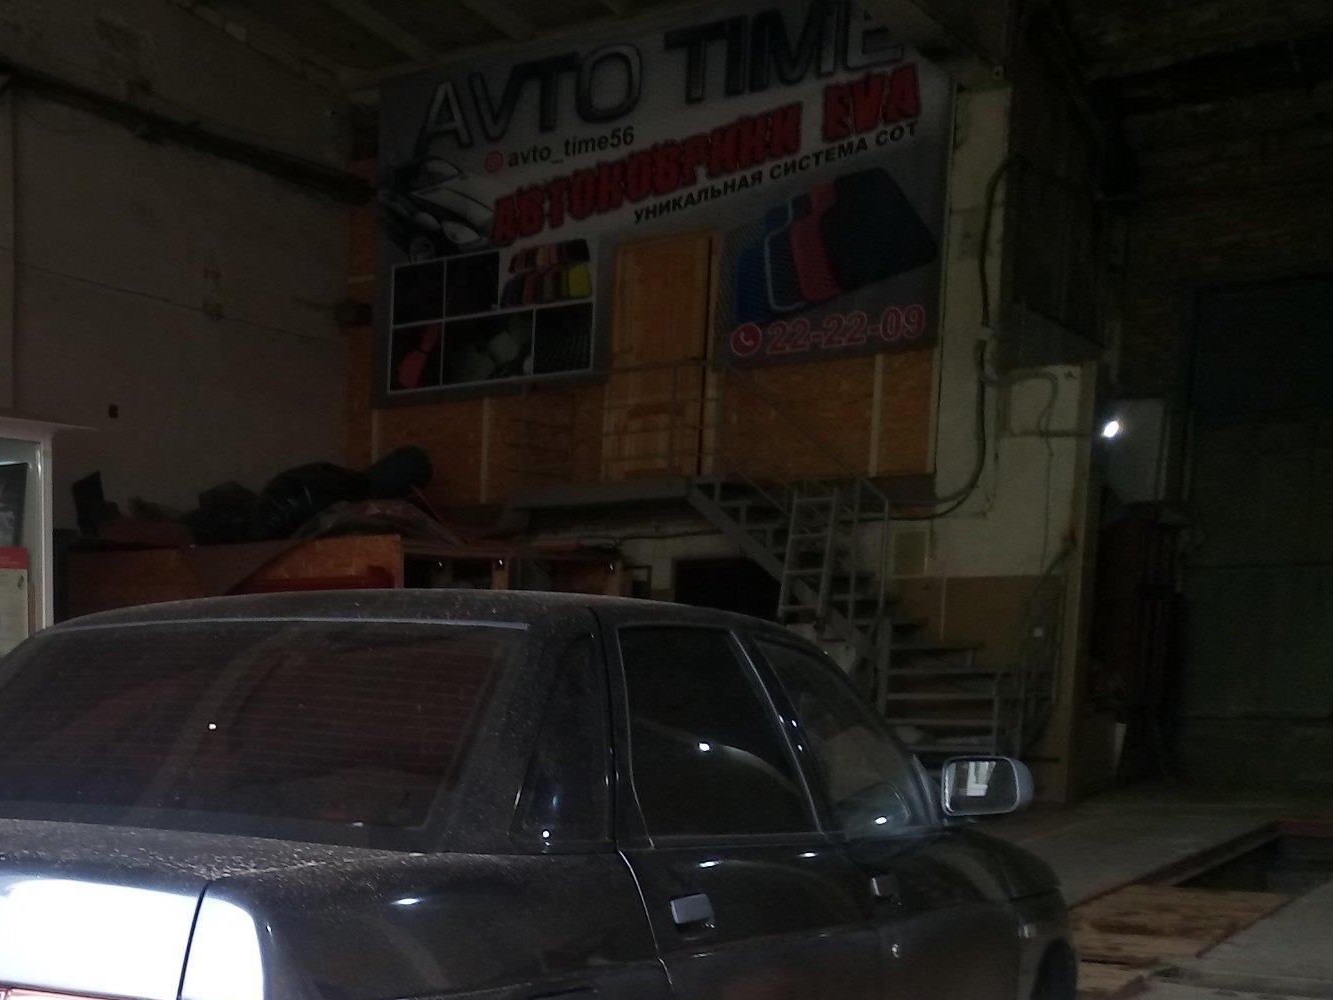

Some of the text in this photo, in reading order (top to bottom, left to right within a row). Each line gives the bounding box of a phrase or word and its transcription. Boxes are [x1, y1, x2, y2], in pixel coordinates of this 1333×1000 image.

[417, 42, 643, 149] AVTO
[507, 126, 635, 168] avto_time56
[492, 63, 920, 249] АВТОКОВРИКИ EVA
[633, 121, 918, 224] УНИКАЛЬНАЯ СИСТЕМА СОТ
[764, 303, 925, 354] 22-22-09
